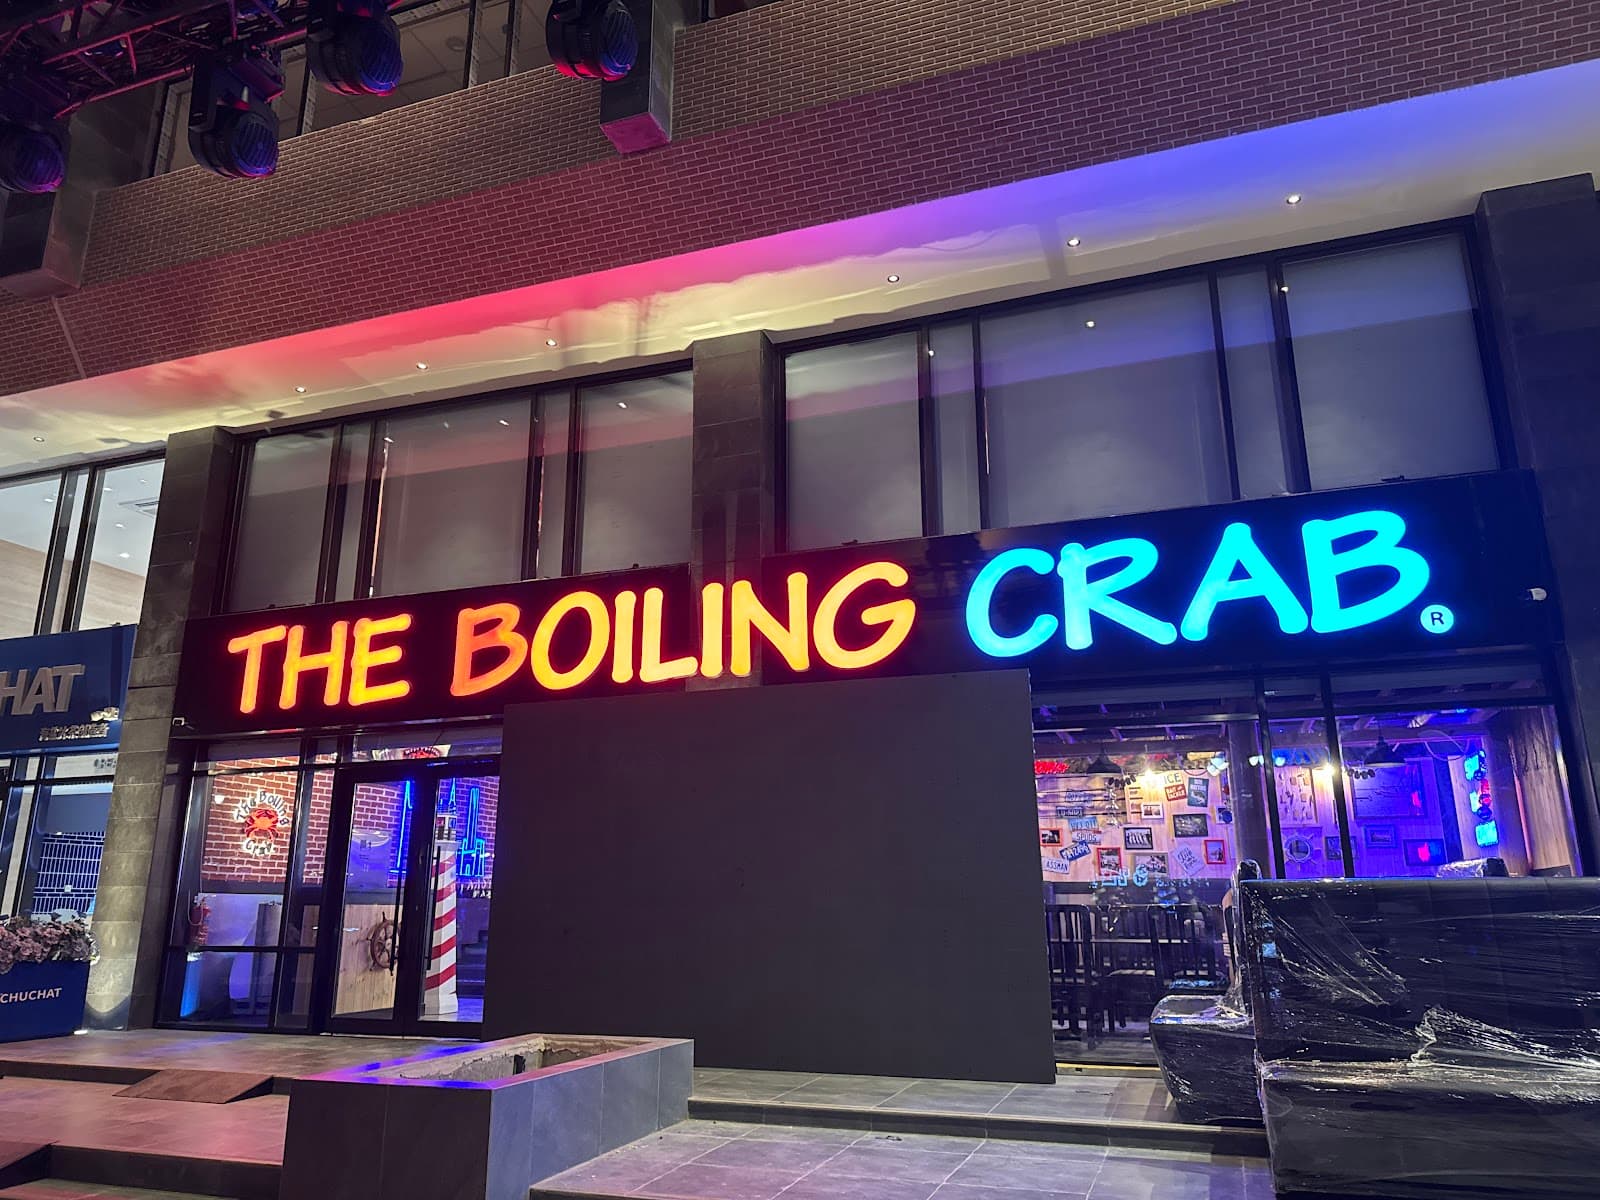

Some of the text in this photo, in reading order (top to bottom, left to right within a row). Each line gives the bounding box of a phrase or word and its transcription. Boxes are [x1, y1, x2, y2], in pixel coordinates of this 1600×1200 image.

[228, 613, 412, 713] THE
[450, 561, 916, 696] BOILING
[965, 510, 1430, 657] CRAB
[0, 987, 63, 1004] CHUCHAT
